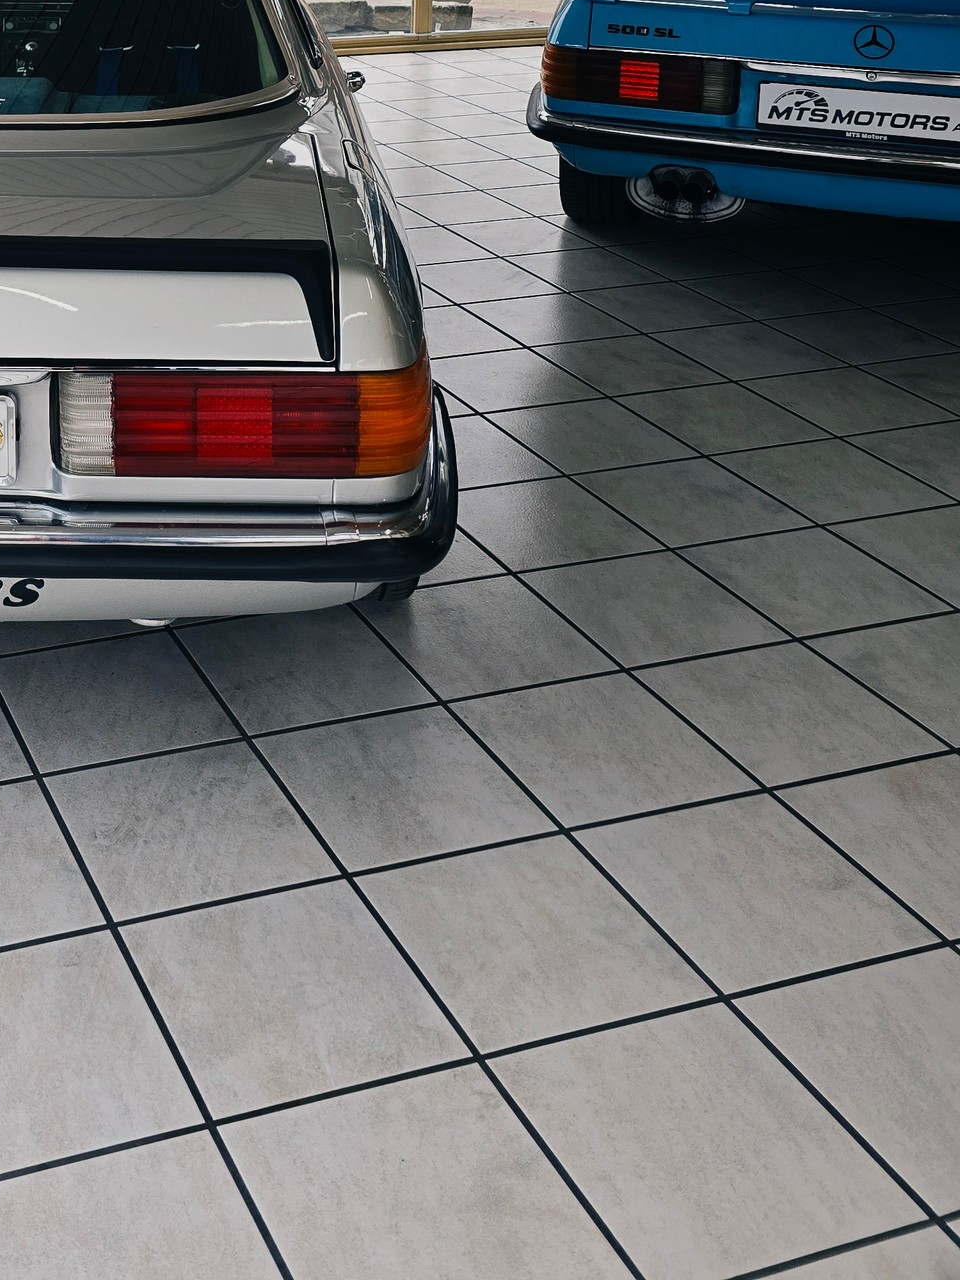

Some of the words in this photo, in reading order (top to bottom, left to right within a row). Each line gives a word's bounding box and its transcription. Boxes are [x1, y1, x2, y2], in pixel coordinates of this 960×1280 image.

[607, 23, 650, 36] 500
[653, 27, 681, 38] SL
[767, 105, 830, 123] MTS
[831, 109, 951, 132] MOTORS
[861, 133, 888, 141] Motors
